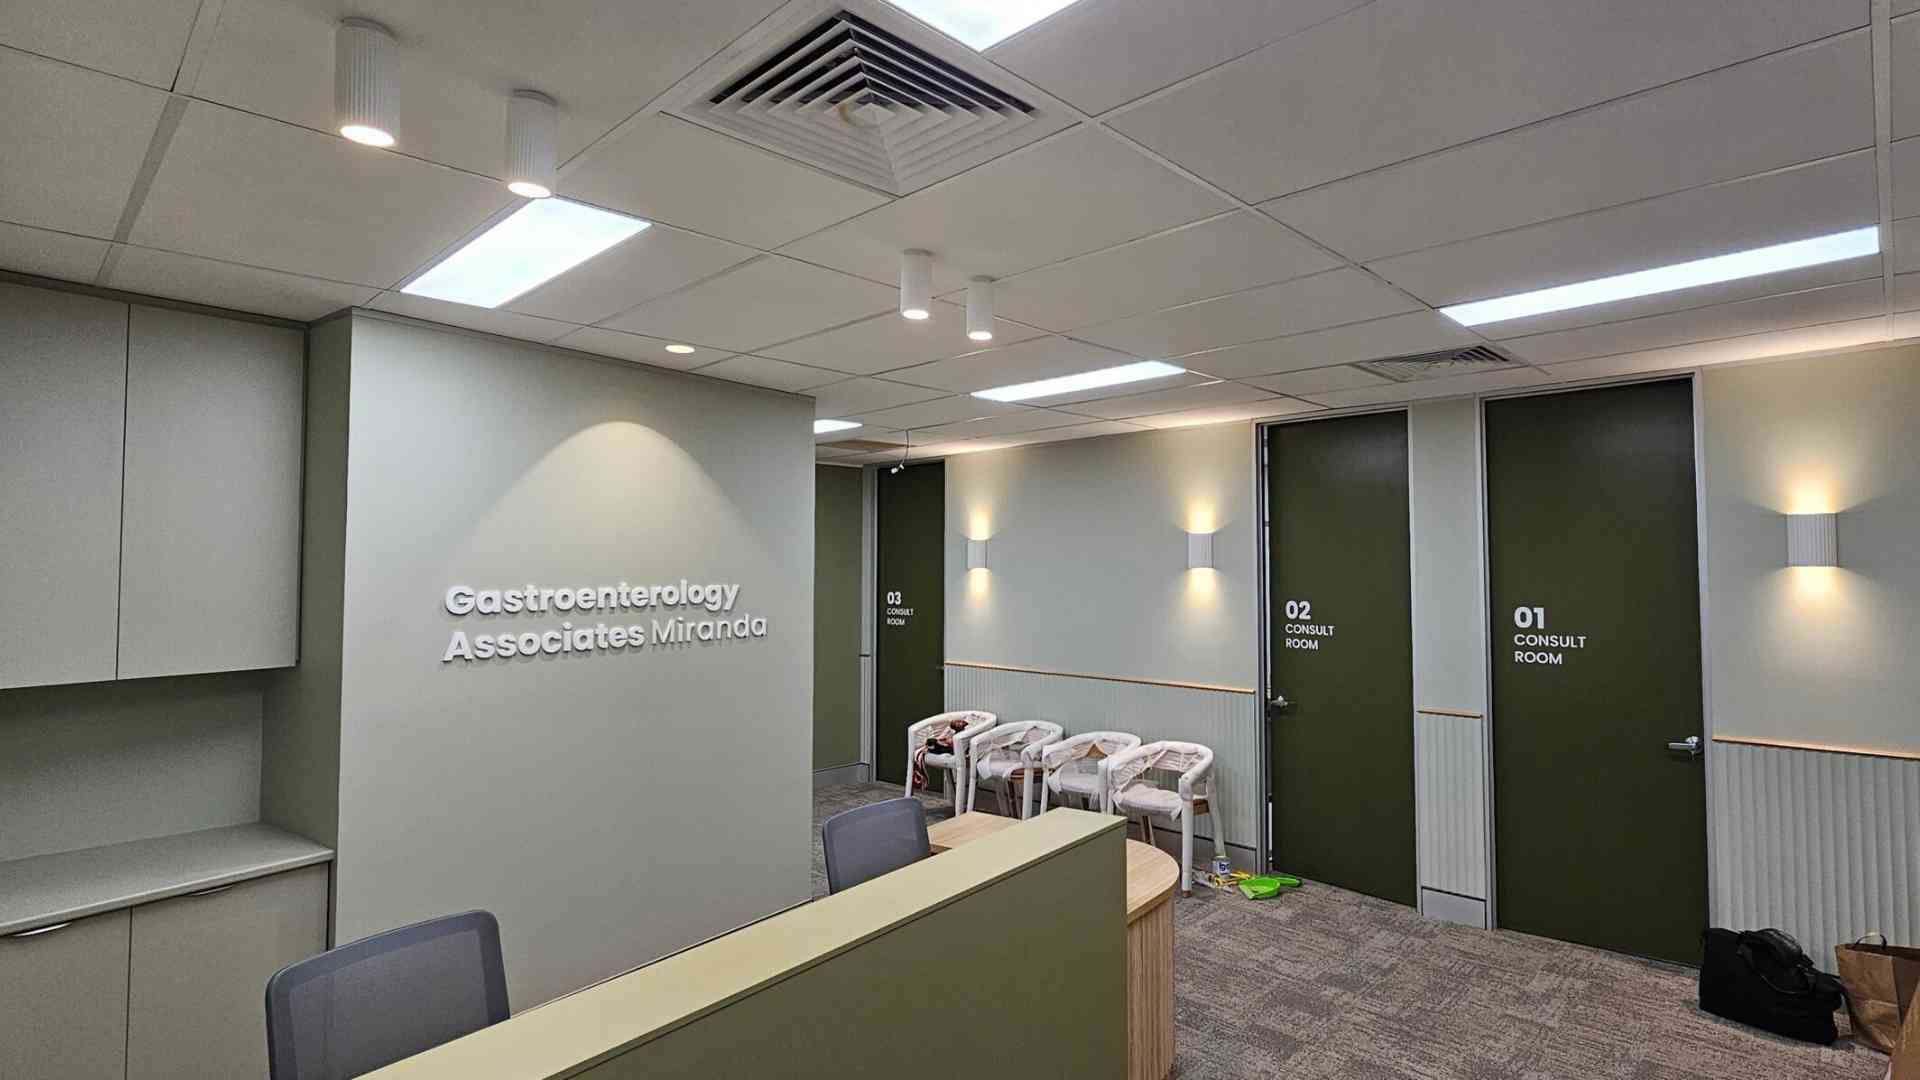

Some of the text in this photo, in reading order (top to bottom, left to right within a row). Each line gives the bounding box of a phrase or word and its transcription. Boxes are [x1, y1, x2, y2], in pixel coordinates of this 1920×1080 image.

[445, 579, 739, 615] Gastroenterology
[887, 591, 901, 605] 03
[1285, 600, 1311, 620] 02
[1514, 606, 1545, 629] 01
[442, 613, 768, 662] Associates Miranda
[1285, 623, 1335, 637] CONSULT
[1285, 638, 1319, 650] ROOM
[1514, 633, 1587, 649] CONSULT
[1514, 650, 1562, 665] ROOM
